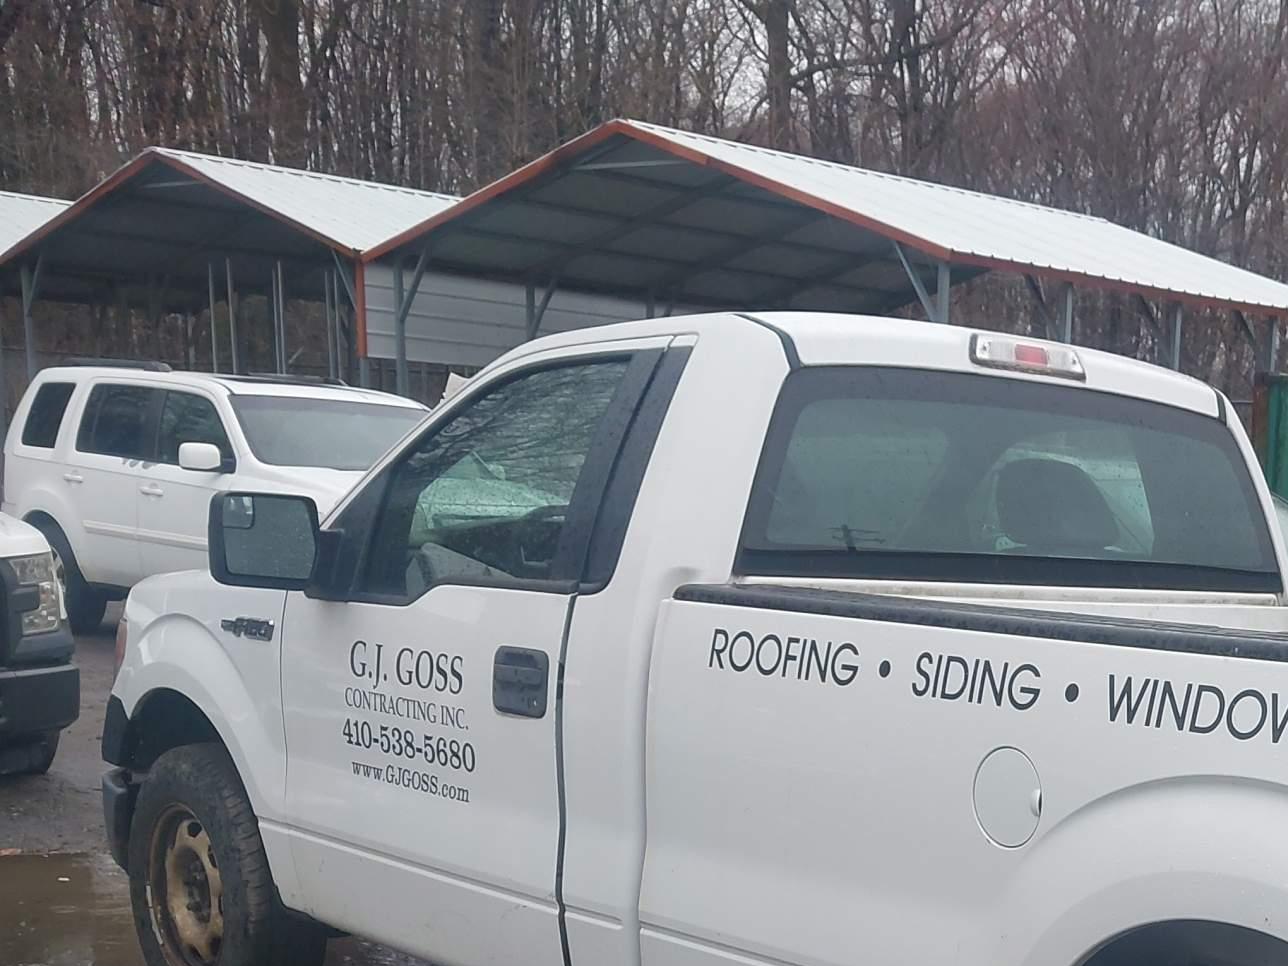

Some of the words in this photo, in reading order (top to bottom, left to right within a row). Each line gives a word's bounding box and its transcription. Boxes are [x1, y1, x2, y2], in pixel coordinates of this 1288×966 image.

[350, 640, 388, 690] G.J.
[396, 647, 464, 694] GOSS
[708, 628, 860, 687] ROOFING
[911, 652, 1042, 711] SIDING
[345, 687, 437, 724] CONTRACTING
[440, 703, 469, 730] INC.
[342, 718, 476, 772] 410-538-5680
[352, 761, 470, 803] www.GJGOSS.com
